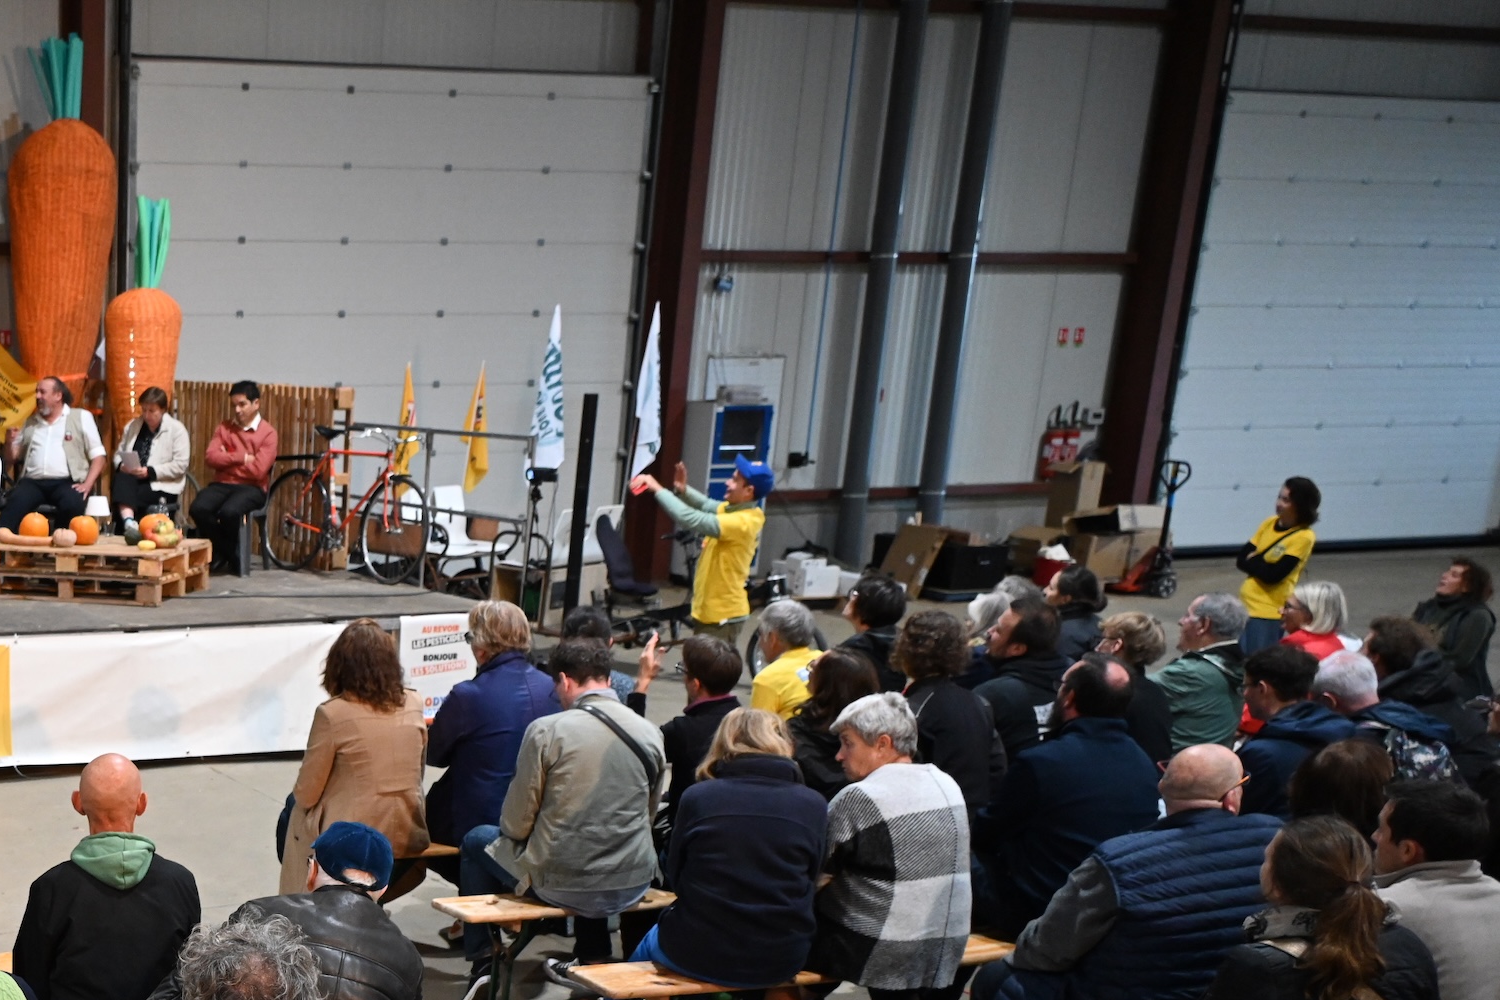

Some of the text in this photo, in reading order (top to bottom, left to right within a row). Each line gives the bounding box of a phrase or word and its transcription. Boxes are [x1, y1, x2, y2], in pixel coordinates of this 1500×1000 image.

[434, 624, 460, 633] REVOIR
[412, 640, 427, 649] LES
[424, 653, 458, 662] BONJOUR
[412, 660, 466, 676] LES SOLUTIONS
